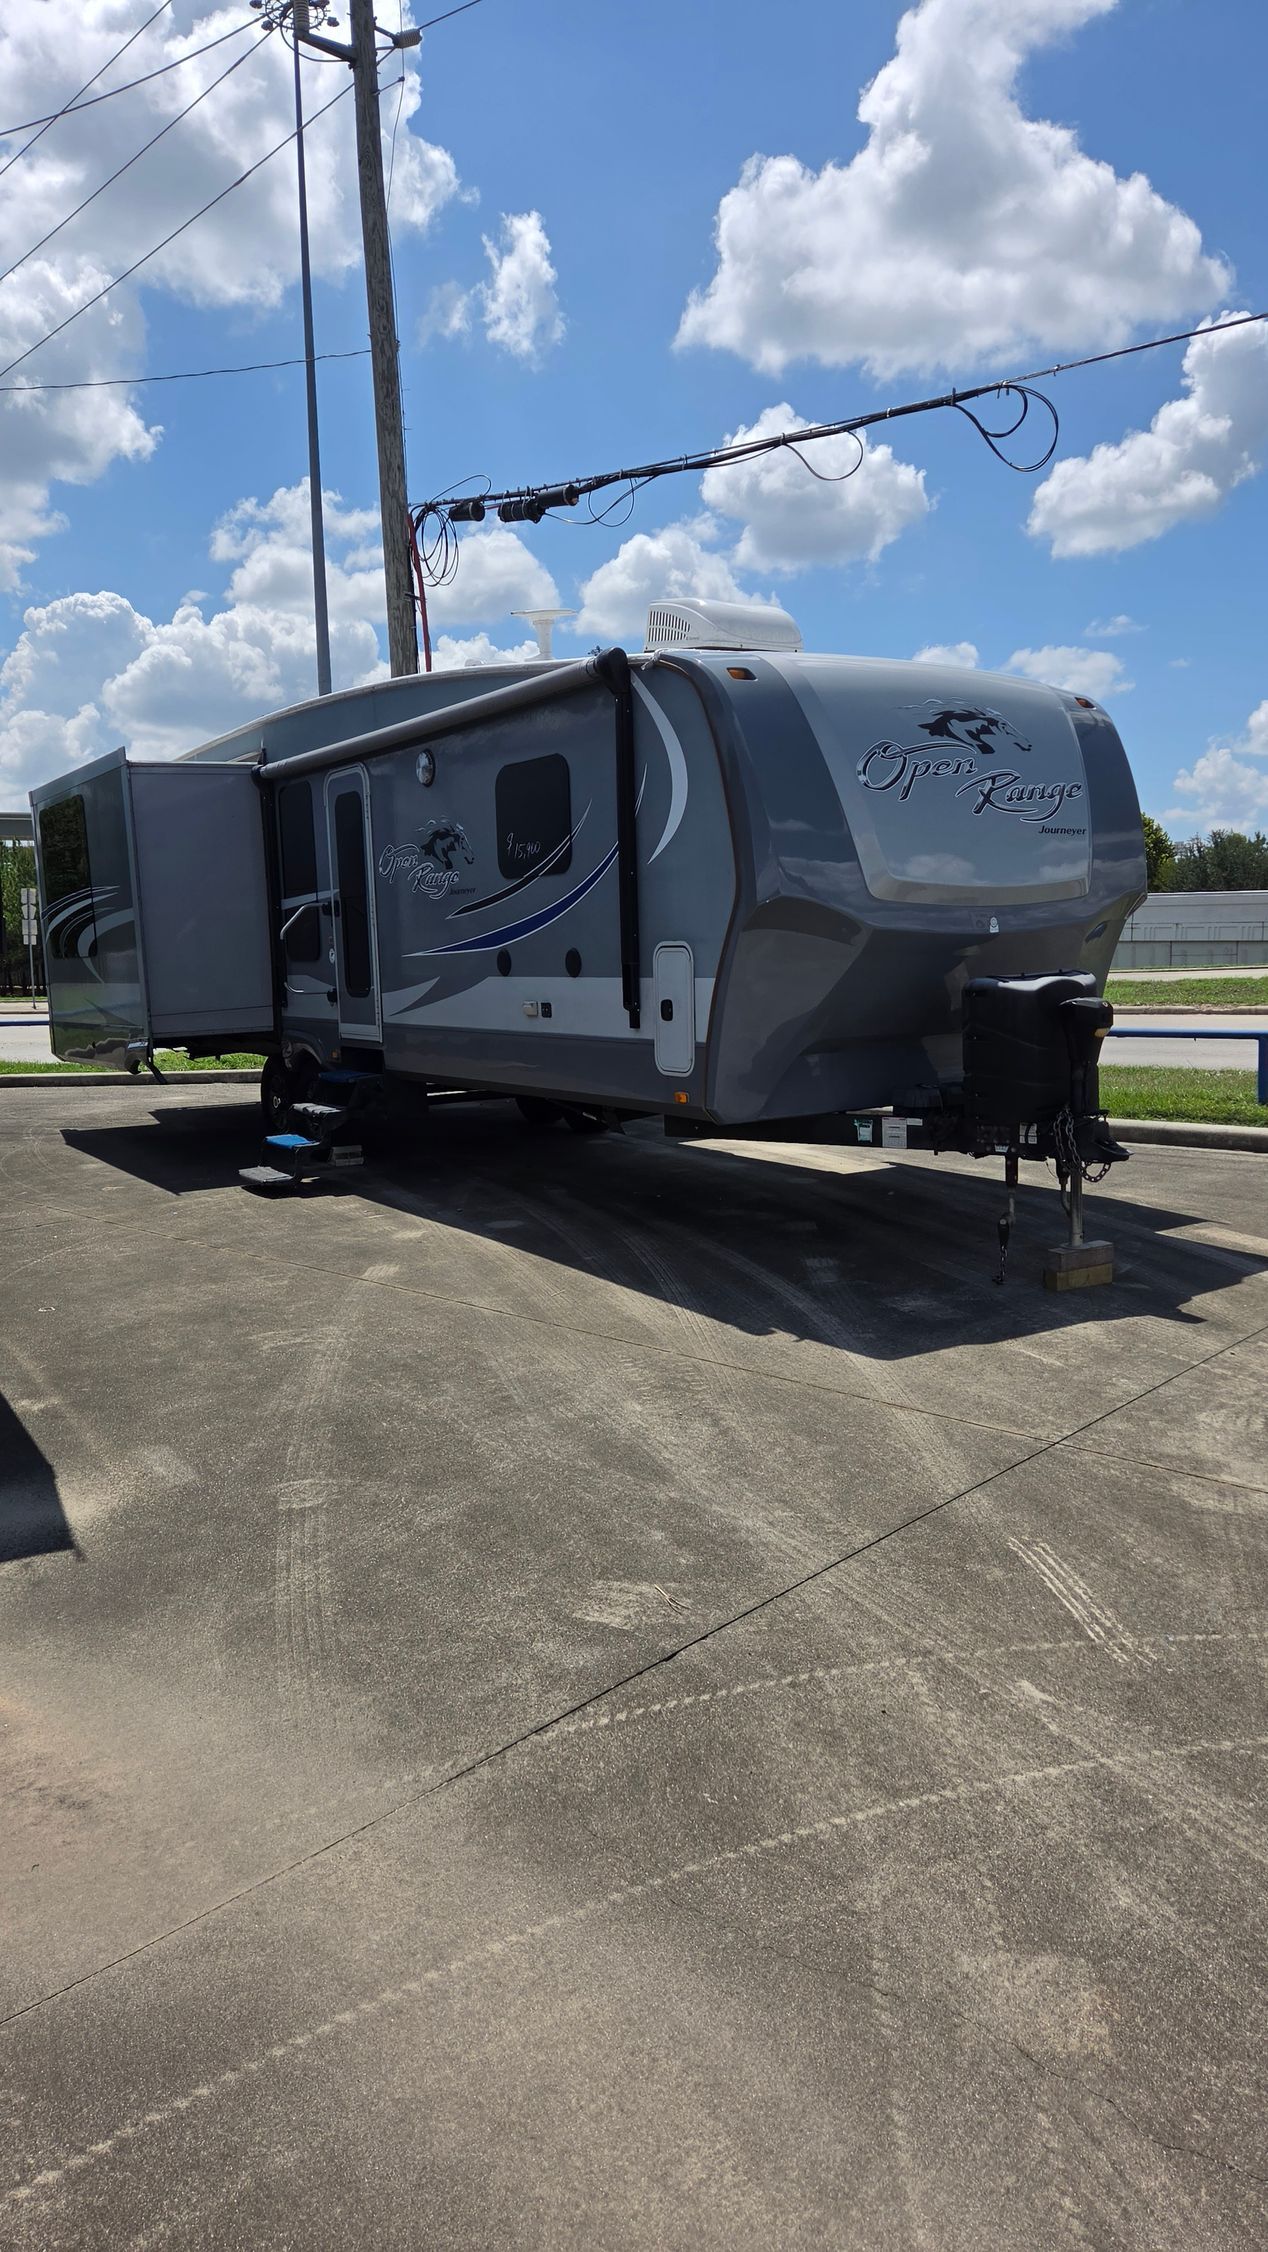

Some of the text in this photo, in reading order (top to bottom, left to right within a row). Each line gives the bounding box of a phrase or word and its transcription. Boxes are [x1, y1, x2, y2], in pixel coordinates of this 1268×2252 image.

[856, 740, 1083, 823] Open Range
[1038, 825, 1087, 836] Journeyer
[379, 843, 459, 899] Open Range
